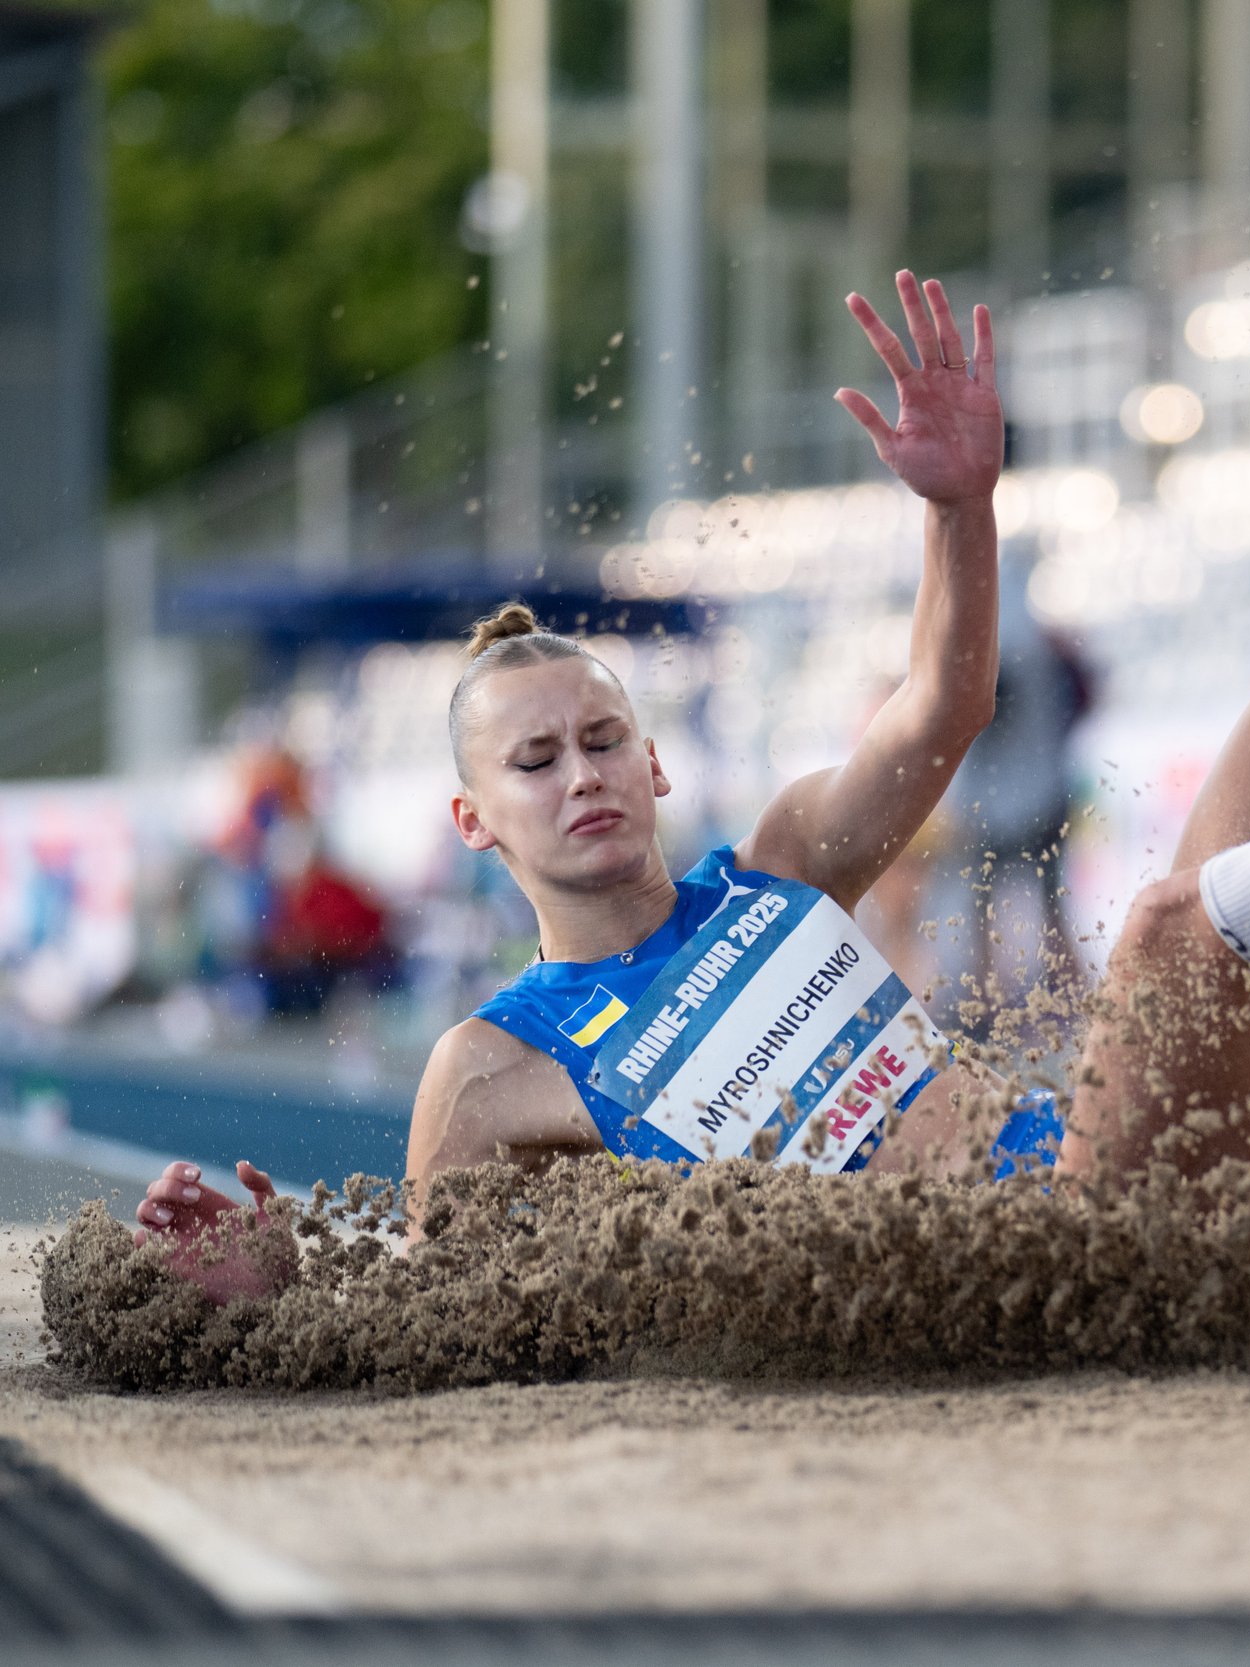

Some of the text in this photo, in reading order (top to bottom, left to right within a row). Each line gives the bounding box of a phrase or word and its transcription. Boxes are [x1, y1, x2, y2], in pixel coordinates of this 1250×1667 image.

[616, 892, 789, 1084] RHINE-RUHR 2025
[697, 942, 860, 1134] MYROSHNICHENKO
[825, 1045, 907, 1141] REWE
